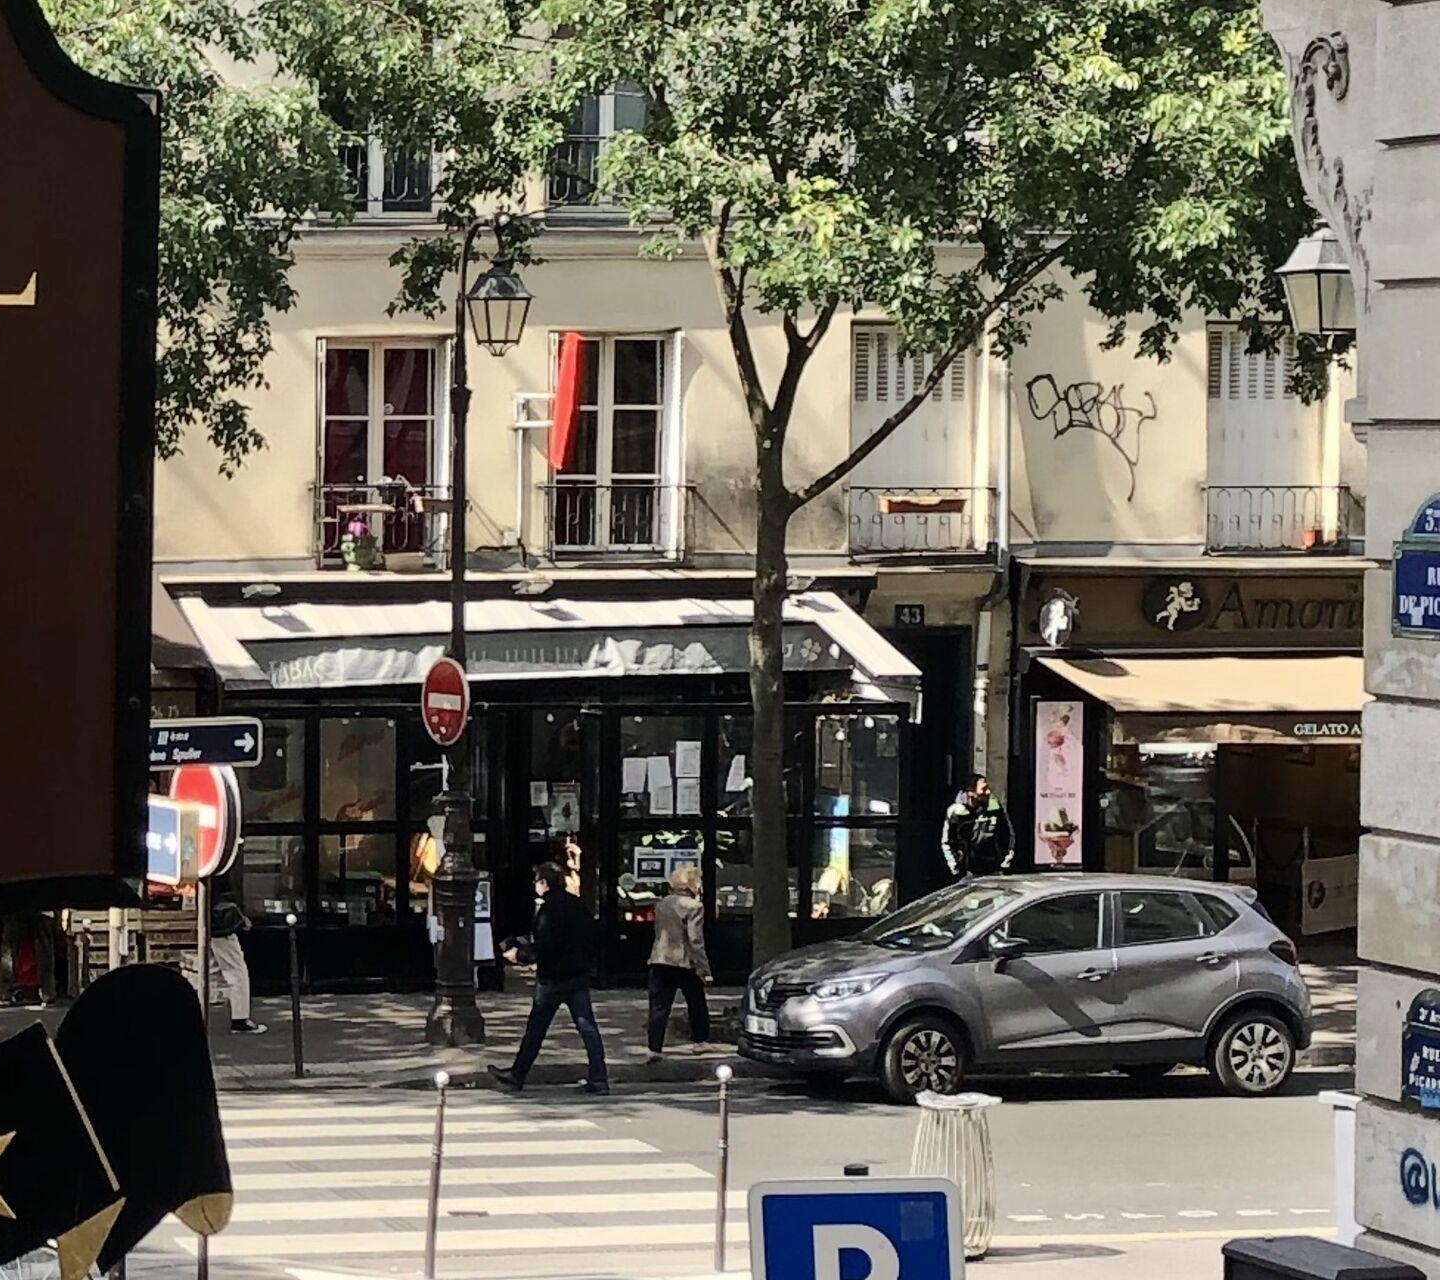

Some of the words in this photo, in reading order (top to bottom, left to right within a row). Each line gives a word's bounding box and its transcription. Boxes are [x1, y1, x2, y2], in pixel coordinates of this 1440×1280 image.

[1205, 581, 1362, 630] Amori
[900, 607, 921, 624] 43
[1294, 724, 1348, 736] GELATO
